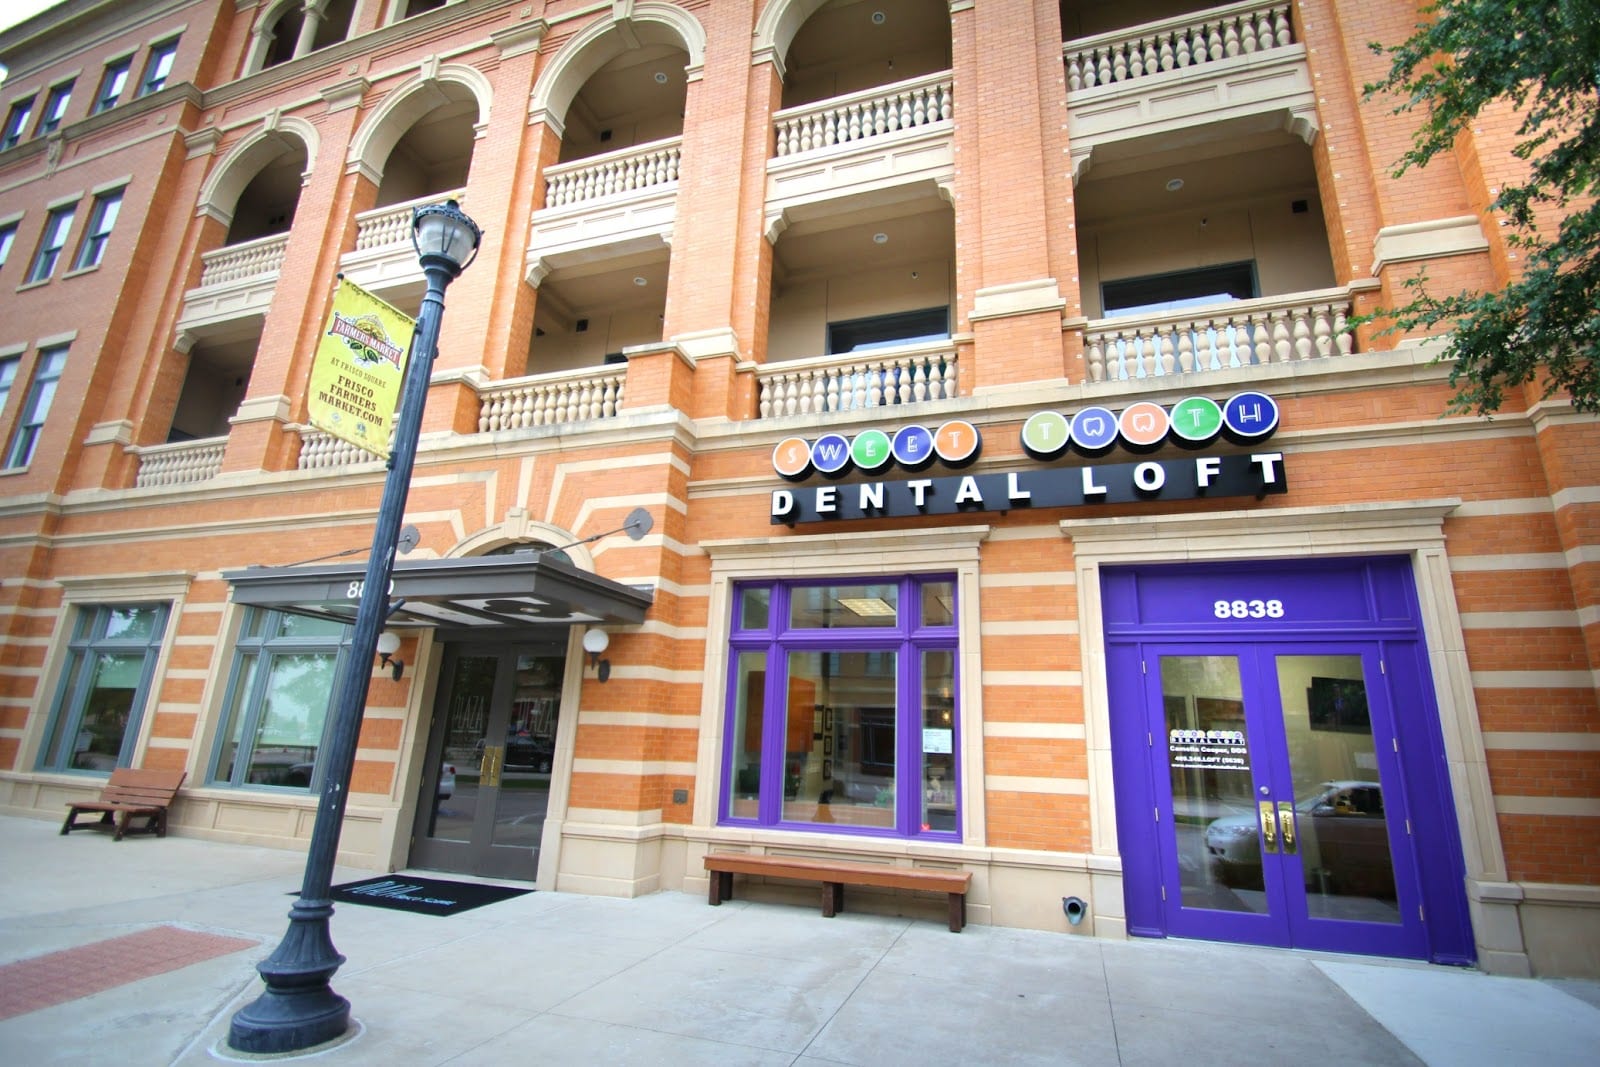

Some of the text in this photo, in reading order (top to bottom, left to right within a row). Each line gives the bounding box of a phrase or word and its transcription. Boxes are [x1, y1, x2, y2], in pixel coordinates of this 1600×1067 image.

[335, 319, 399, 361] FARMERS MARKET
[330, 356, 387, 389] AT FRISCO SQUARE
[337, 375, 374, 398] FRISCO
[318, 391, 383, 427] MARKET.COM
[329, 384, 377, 412] FARMERS
[784, 429, 963, 466] SWEET
[771, 452, 1282, 516] DENTAL LOFT
[1214, 600, 1284, 618] 8838
